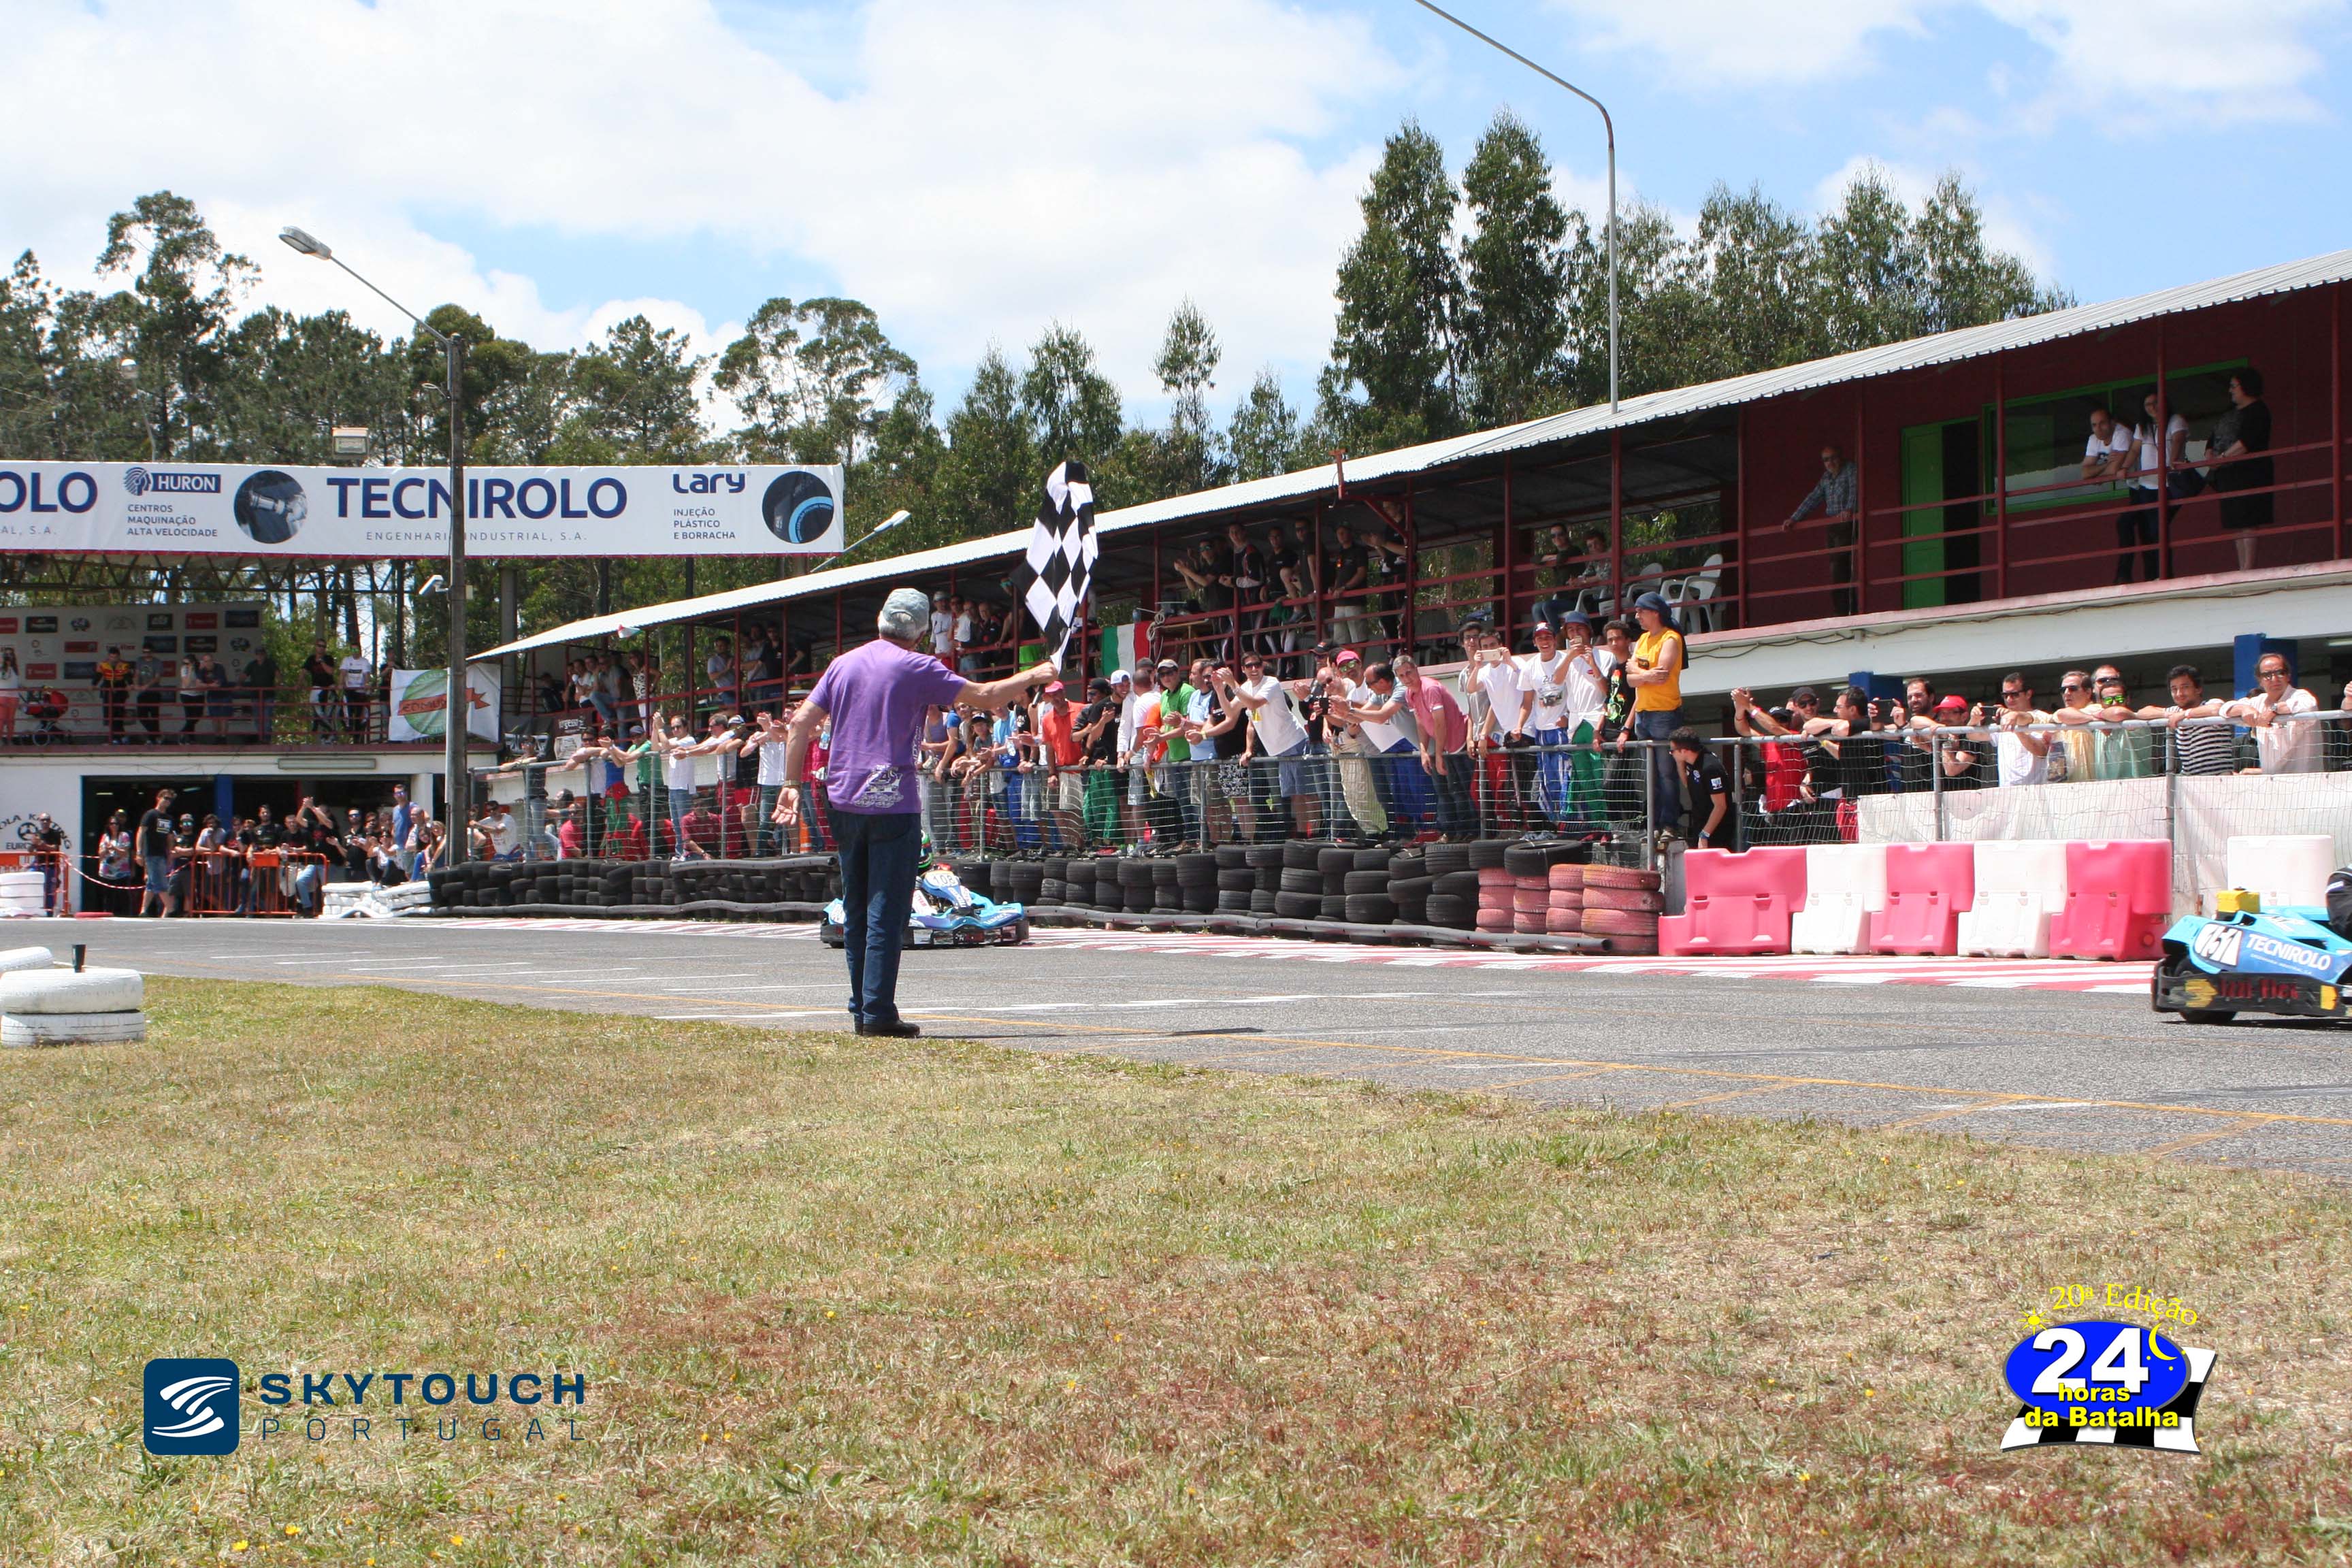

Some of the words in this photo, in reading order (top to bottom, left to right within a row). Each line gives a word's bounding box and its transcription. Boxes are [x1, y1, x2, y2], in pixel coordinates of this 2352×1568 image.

[158, 475, 216, 491] HURON
[327, 477, 627, 519] TECNIROLO
[127, 504, 173, 512] CENTROS
[673, 506, 716, 518] INJEÇÃO
[127, 515, 196, 526] MAQUINAÇÃO
[673, 519, 720, 528] PLÁSTICO
[29, 526, 57, 535] S.A.
[127, 528, 152, 536] ALTA
[155, 528, 218, 537] VELOCIDADE
[366, 532, 451, 540] ENGENHARI
[464, 532, 553, 542] INDUSTRIAL,
[560, 532, 587, 541] S.A.
[673, 532, 680, 540] E
[682, 532, 736, 540] BORRACHA
[933, 875, 956, 885] 108
[2246, 933, 2332, 971] TECNIROLO
